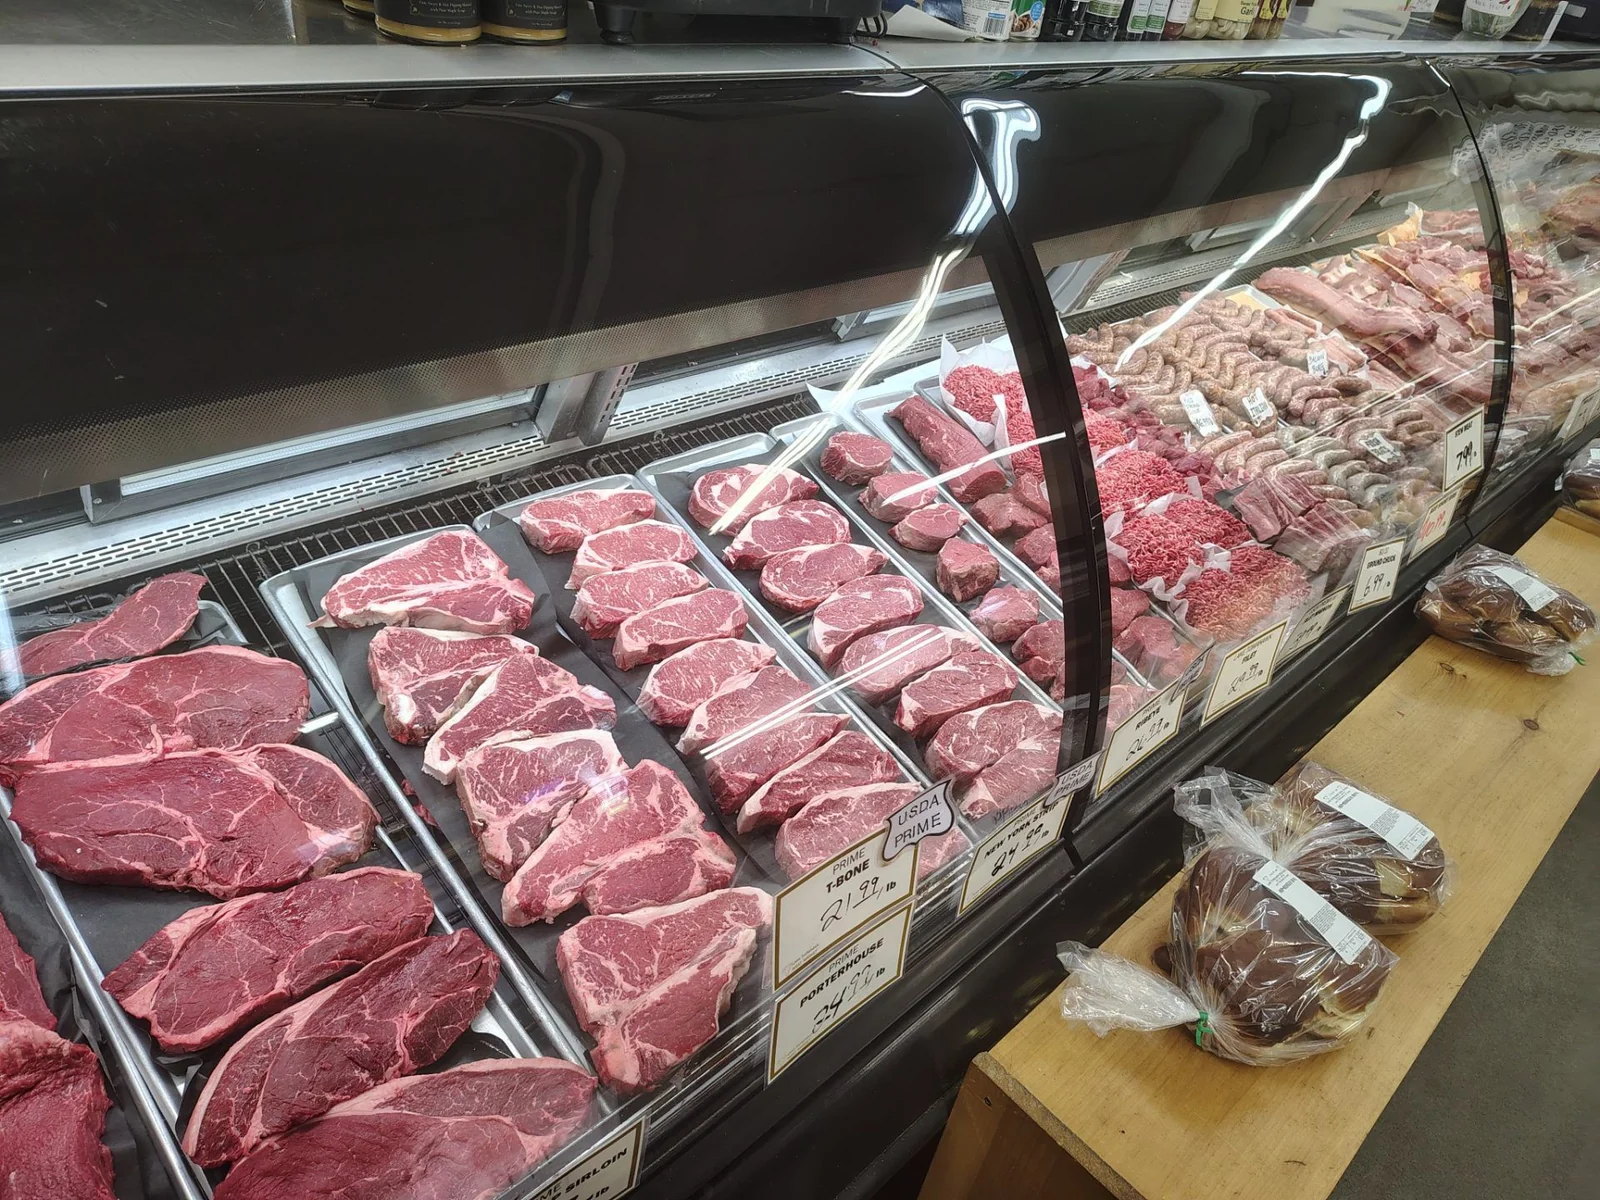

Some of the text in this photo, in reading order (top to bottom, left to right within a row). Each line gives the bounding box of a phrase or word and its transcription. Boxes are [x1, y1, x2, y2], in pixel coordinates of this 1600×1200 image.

[1135, 705, 1162, 731] RIBEYE
[1054, 772, 1090, 797] PRIME
[1061, 761, 1094, 785] USDA
[894, 812, 942, 848] PRIME
[984, 837, 1006, 859] NEW
[1007, 821, 1031, 841] YORK
[825, 858, 871, 893] T-BONE
[832, 847, 866, 875] PRIME
[799, 937, 884, 1009] PORTERHOUSE
[828, 943, 860, 973] PRIME
[565, 1147, 628, 1193] SIRLOIN
